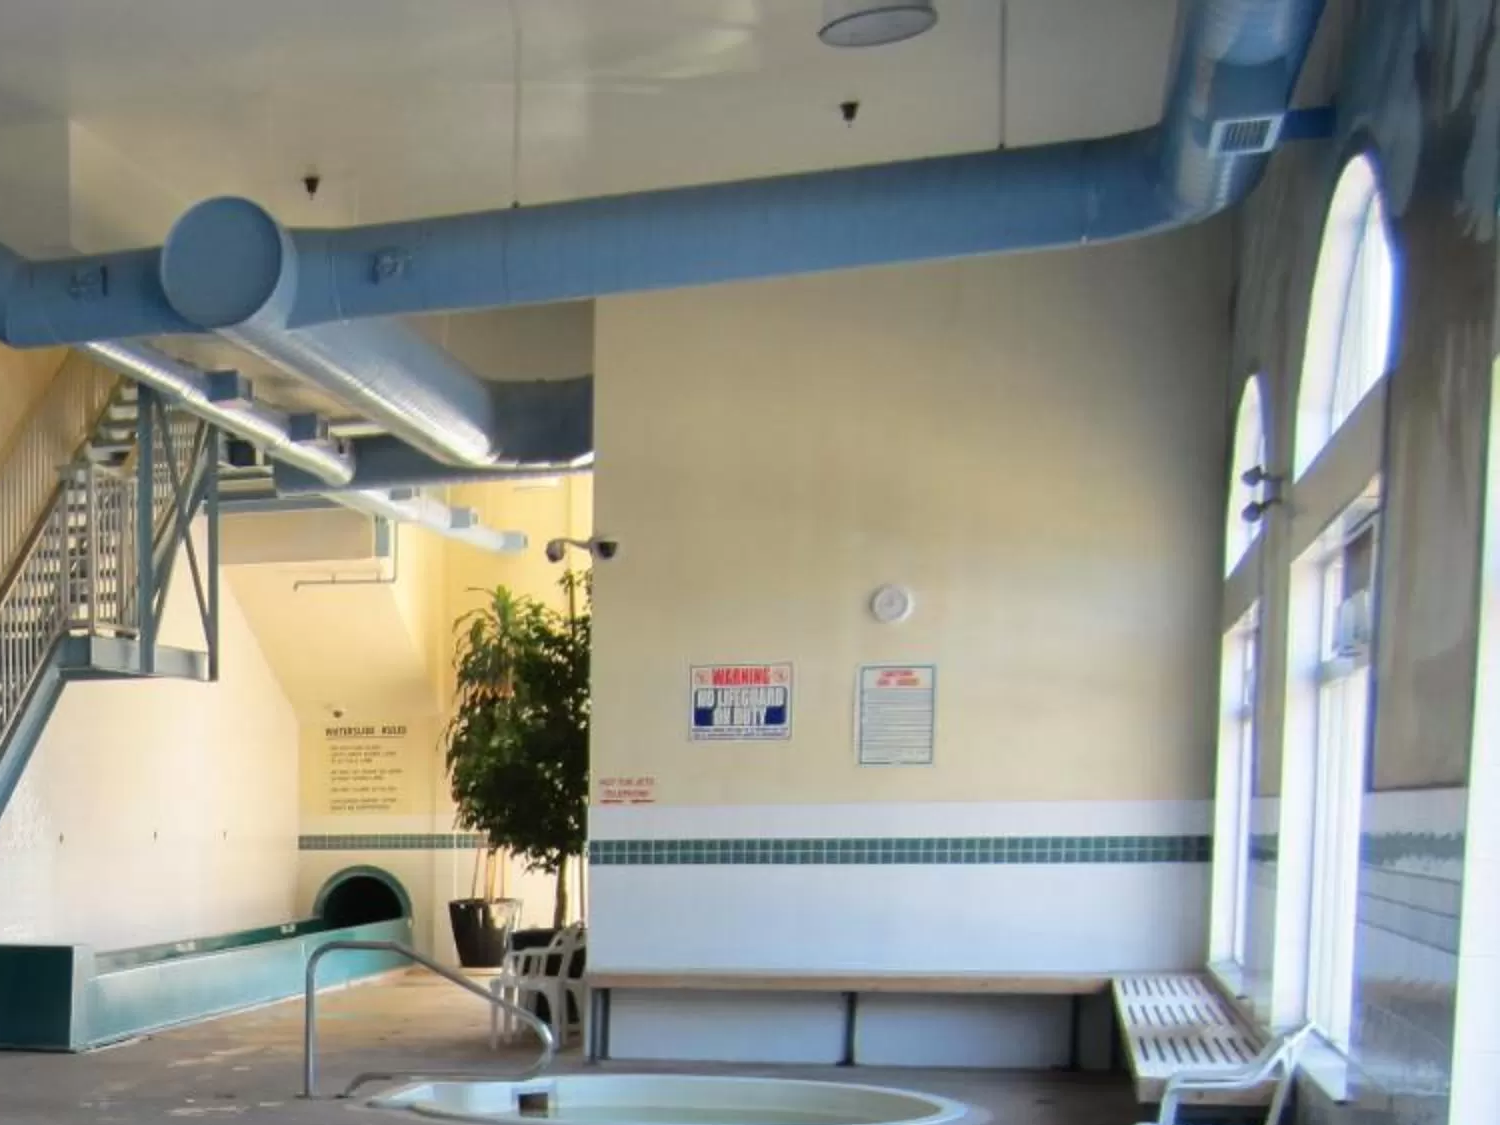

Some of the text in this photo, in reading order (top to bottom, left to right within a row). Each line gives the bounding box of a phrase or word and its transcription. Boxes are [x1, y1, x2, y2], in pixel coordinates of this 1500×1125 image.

[711, 667, 771, 686] WARNING
[717, 686, 785, 708] LIFEGUARD
[733, 705, 767, 726] DUTY
